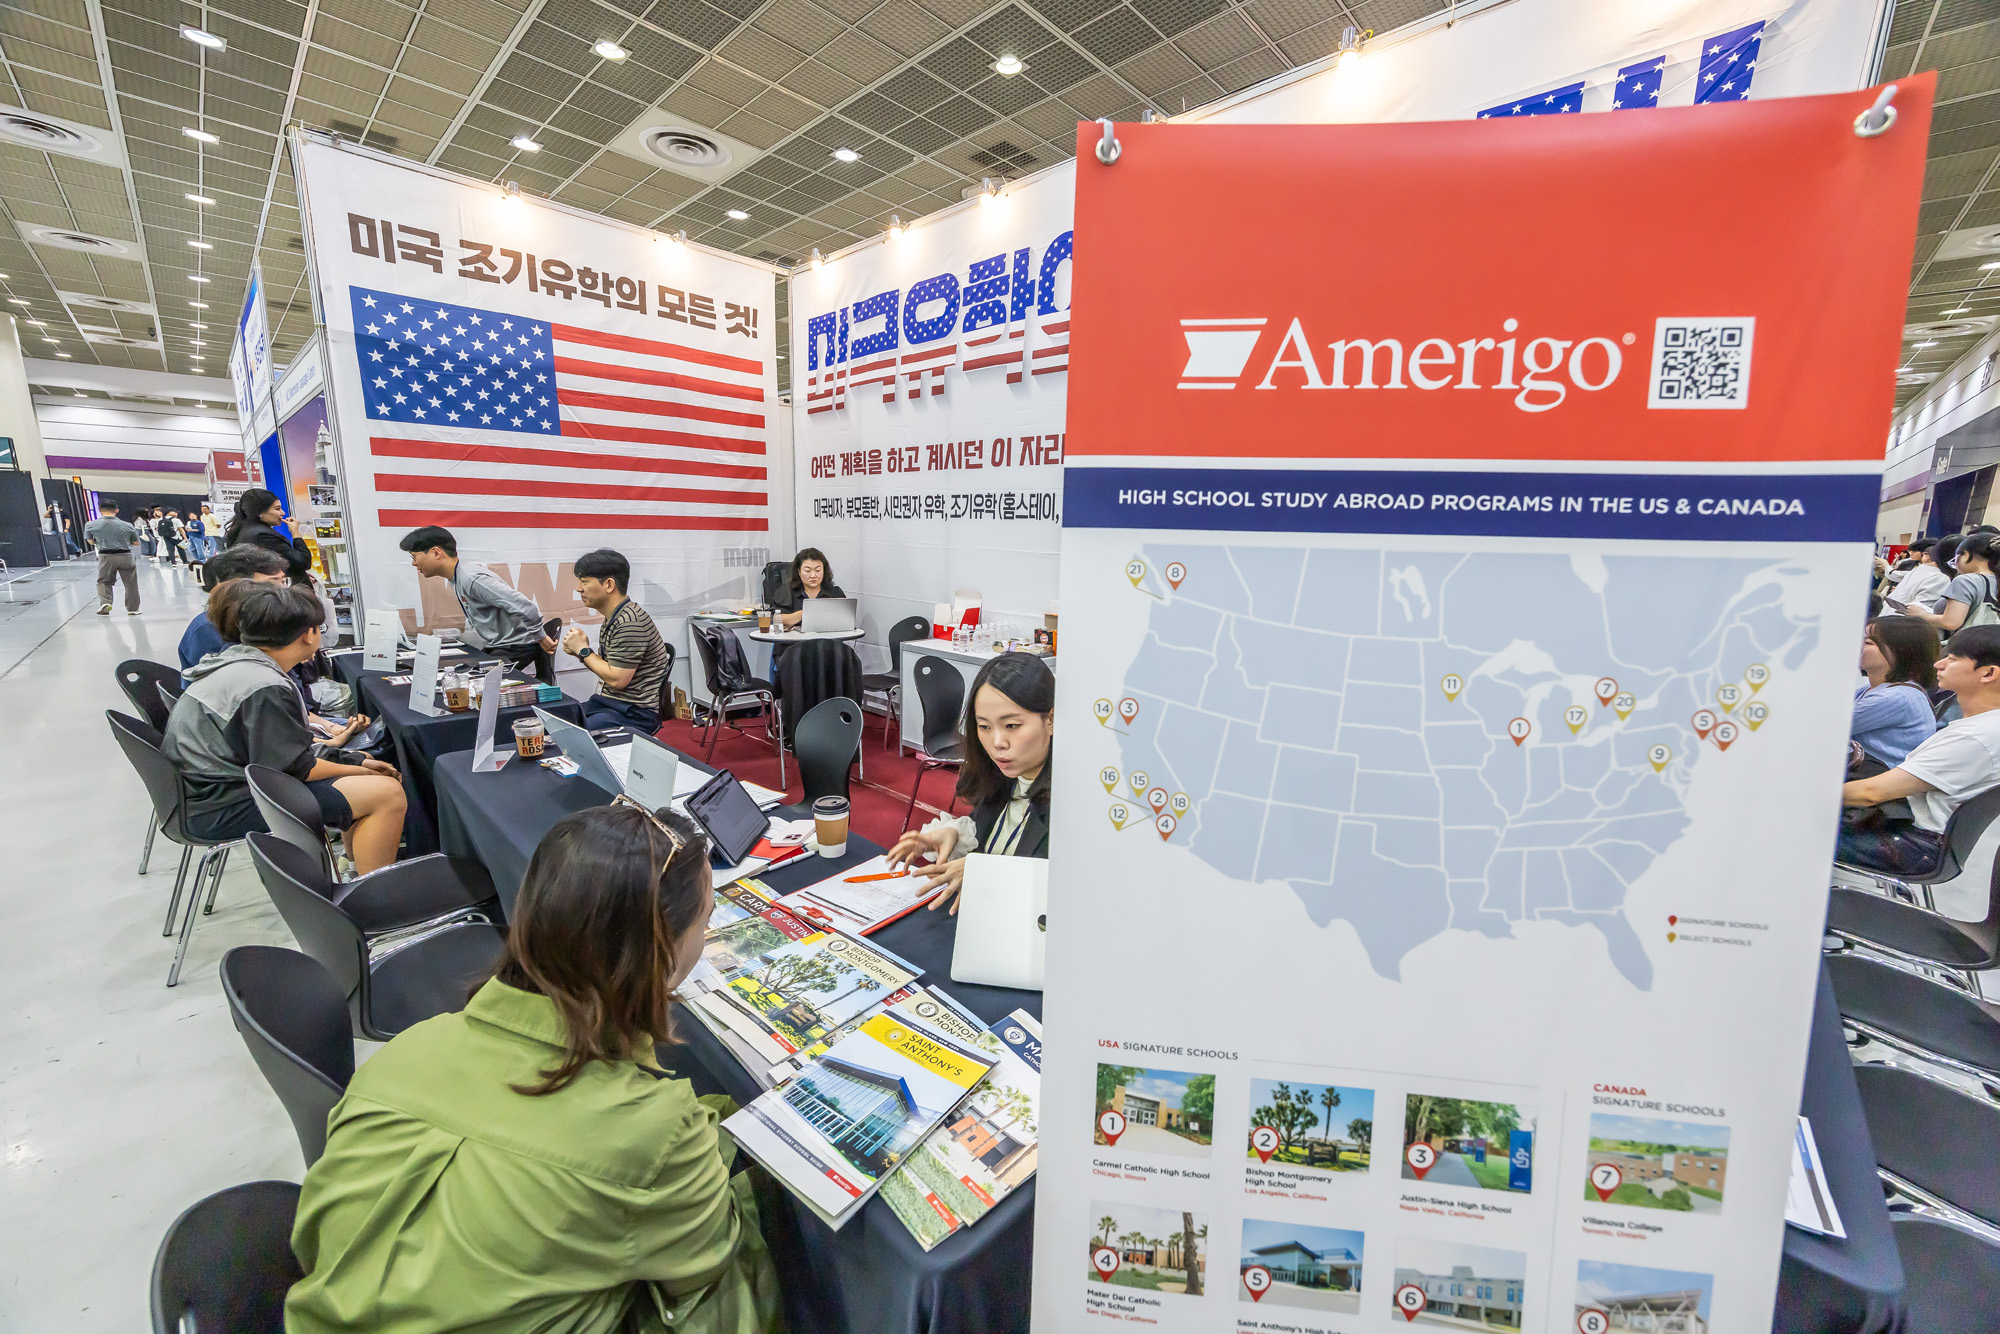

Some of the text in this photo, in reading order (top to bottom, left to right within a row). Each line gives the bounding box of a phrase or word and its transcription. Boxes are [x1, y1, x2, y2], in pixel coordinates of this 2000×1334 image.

[347, 212, 759, 339] 미국 조기유학의 모든 것!
[811, 453, 836, 479] 어떤
[840, 448, 883, 476] 계획을
[886, 445, 921, 474] 하고
[925, 439, 984, 471] 계시던
[990, 437, 1012, 468] 이
[846, 495, 882, 521] 부모동반,
[883, 494, 922, 520] 시민권자
[924, 494, 948, 521] 유학,
[1118, 489, 1805, 516] HIGH SCHOOL STUDY ABROAD PROGRAMS IN THE US & CANADA
[723, 547, 771, 568] mom
[1129, 564, 1142, 575] 21
[1171, 567, 1180, 578] 8
[1750, 668, 1766, 680] 19
[1446, 679, 1457, 689] 11
[1602, 683, 1612, 694] 7
[1722, 688, 1736, 700] 13
[1096, 703, 1110, 714] 14
[1124, 702, 1133, 714] 3
[1616, 696, 1634, 707] 20
[1569, 711, 1584, 721] 17
[1749, 707, 1766, 719] 10
[1699, 715, 1709, 727] 5
[1517, 723, 1522, 734] 1
[1720, 727, 1731, 739] 6
[1654, 748, 1665, 760] 9
[1103, 771, 1116, 781] 16
[1133, 775, 1146, 786] 15
[1154, 792, 1162, 803] 2
[1174, 797, 1186, 808] 18
[1113, 809, 1125, 819] 12
[1161, 819, 1169, 829] 4
[1729, 921, 1769, 931] SCHOOLS
[1712, 937, 1752, 946] SCHOOLS
[850, 946, 882, 964] BISHOP
[843, 949, 901, 985] MONTGOMERY
[934, 1017, 968, 1042] MONT
[908, 1034, 943, 1054] SAINT
[1098, 1038, 1239, 1061] USA SIGNATURE SCHOOLS
[900, 1041, 963, 1077] ANTHONY'S
[1593, 1083, 1647, 1097] CANADA
[1592, 1095, 1726, 1118] SIGNATURE SCHOOLS
[1108, 1117, 1115, 1130] 1
[1259, 1133, 1271, 1147] 2
[776, 1127, 795, 1145] STUDENT
[793, 1142, 810, 1159] SCHOOL
[809, 1156, 824, 1169] GUIDE
[1415, 1149, 1427, 1164] 3
[1092, 1159, 1211, 1180] Carmel Catholic High School
[1245, 1167, 1333, 1184] Bishop Montgomery
[1245, 1178, 1297, 1190] High School
[1600, 1170, 1612, 1184] 7
[1244, 1187, 1328, 1202] Los Angeles, California
[1400, 1194, 1512, 1214] Justin-Siena High School
[1582, 1216, 1664, 1233] Villanova College
[1100, 1254, 1111, 1267] 4
[1252, 1272, 1262, 1286] 5
[1087, 1288, 1162, 1307] Mater Dei Catholic
[1405, 1291, 1417, 1306] 6
[1086, 1298, 1136, 1313] High School
[1086, 1307, 1100, 1316] San
[1125, 1313, 1158, 1325] California
[1237, 1319, 1258, 1328] Saint
[1260, 1322, 1303, 1334] Anthony's
[1587, 1316, 1599, 1331] 8
